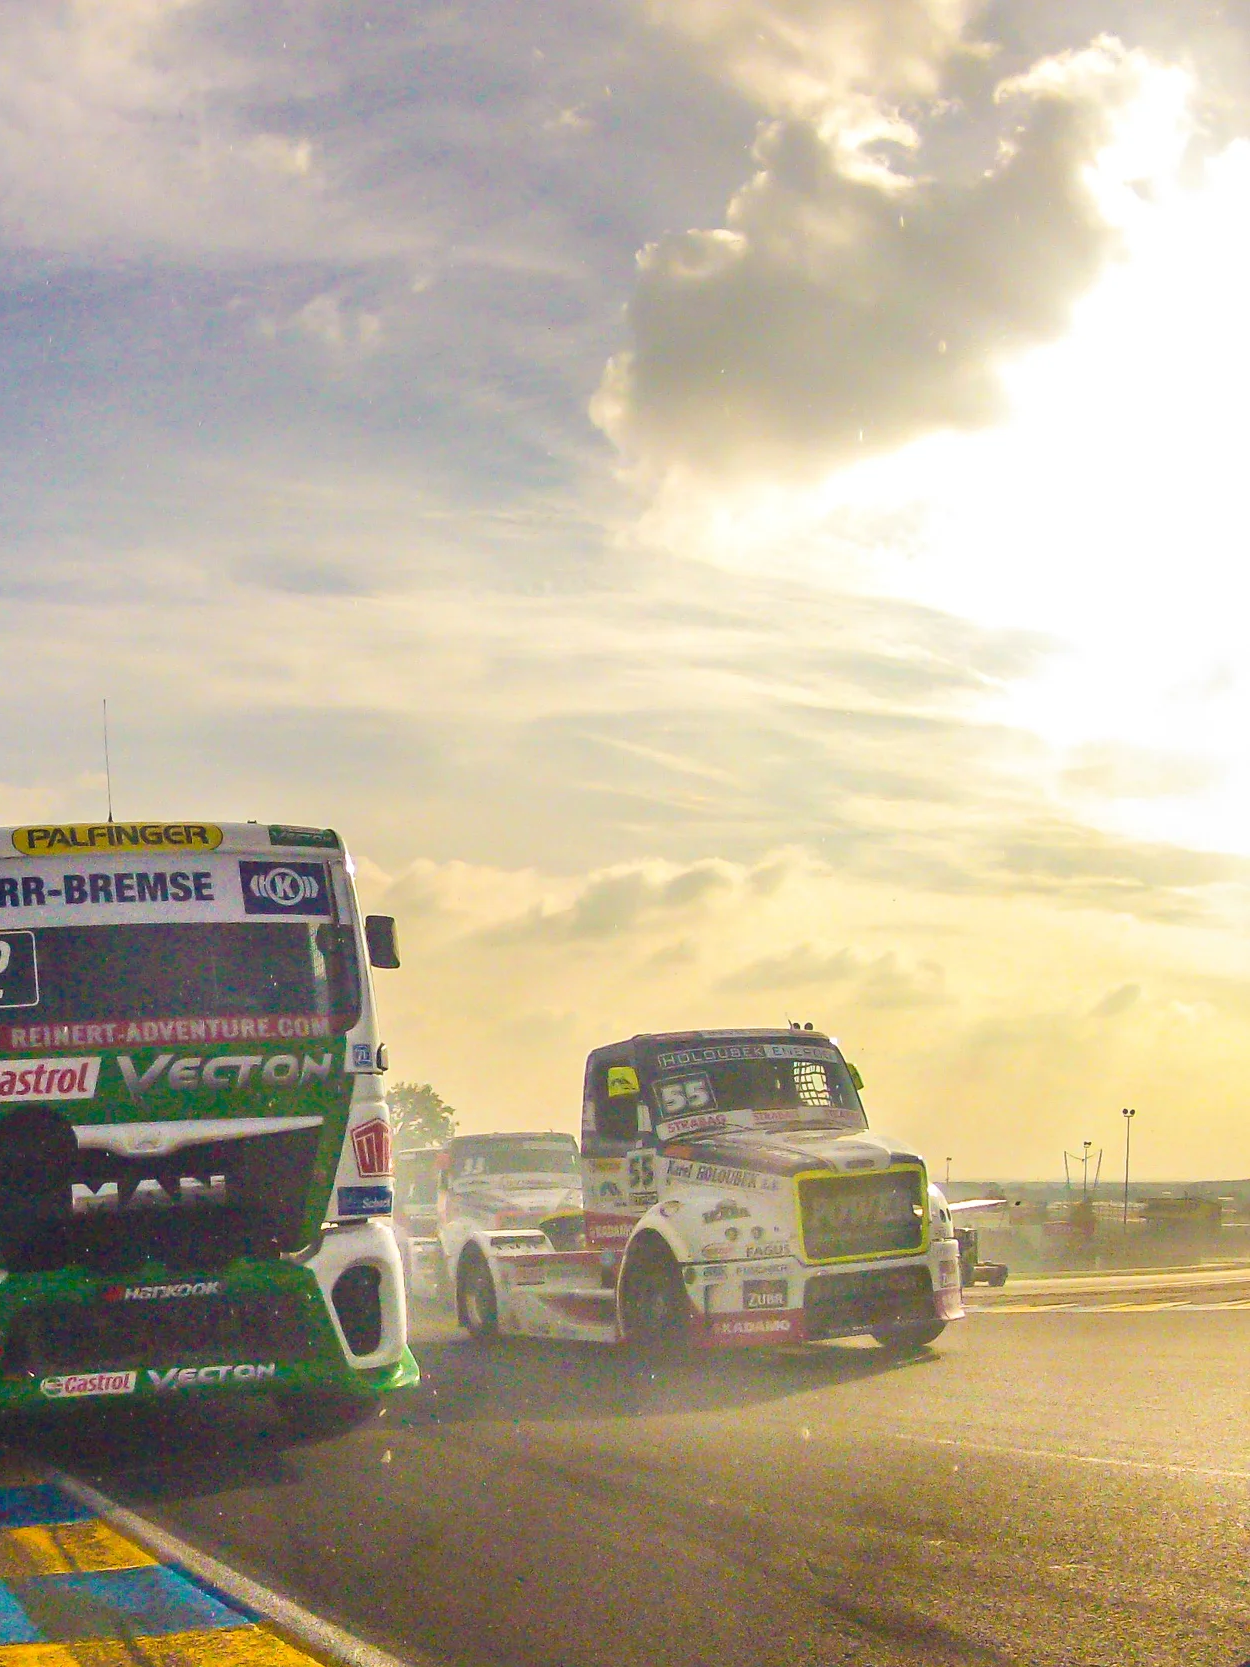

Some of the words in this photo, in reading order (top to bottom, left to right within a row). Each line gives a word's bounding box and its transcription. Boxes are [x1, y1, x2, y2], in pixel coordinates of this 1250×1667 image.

[27, 825, 210, 849] PALFINGER
[11, 1016, 330, 1049] REINERT-ADVENTURE.COM
[116, 1052, 333, 1096] VECTON
[662, 1047, 765, 1068] HOLOUBEK
[661, 1078, 711, 1114] 55
[628, 1155, 654, 1187] 55
[71, 1174, 227, 1213] MAN
[63, 1373, 130, 1395] Castrol
[146, 1361, 277, 1390] VECTON
